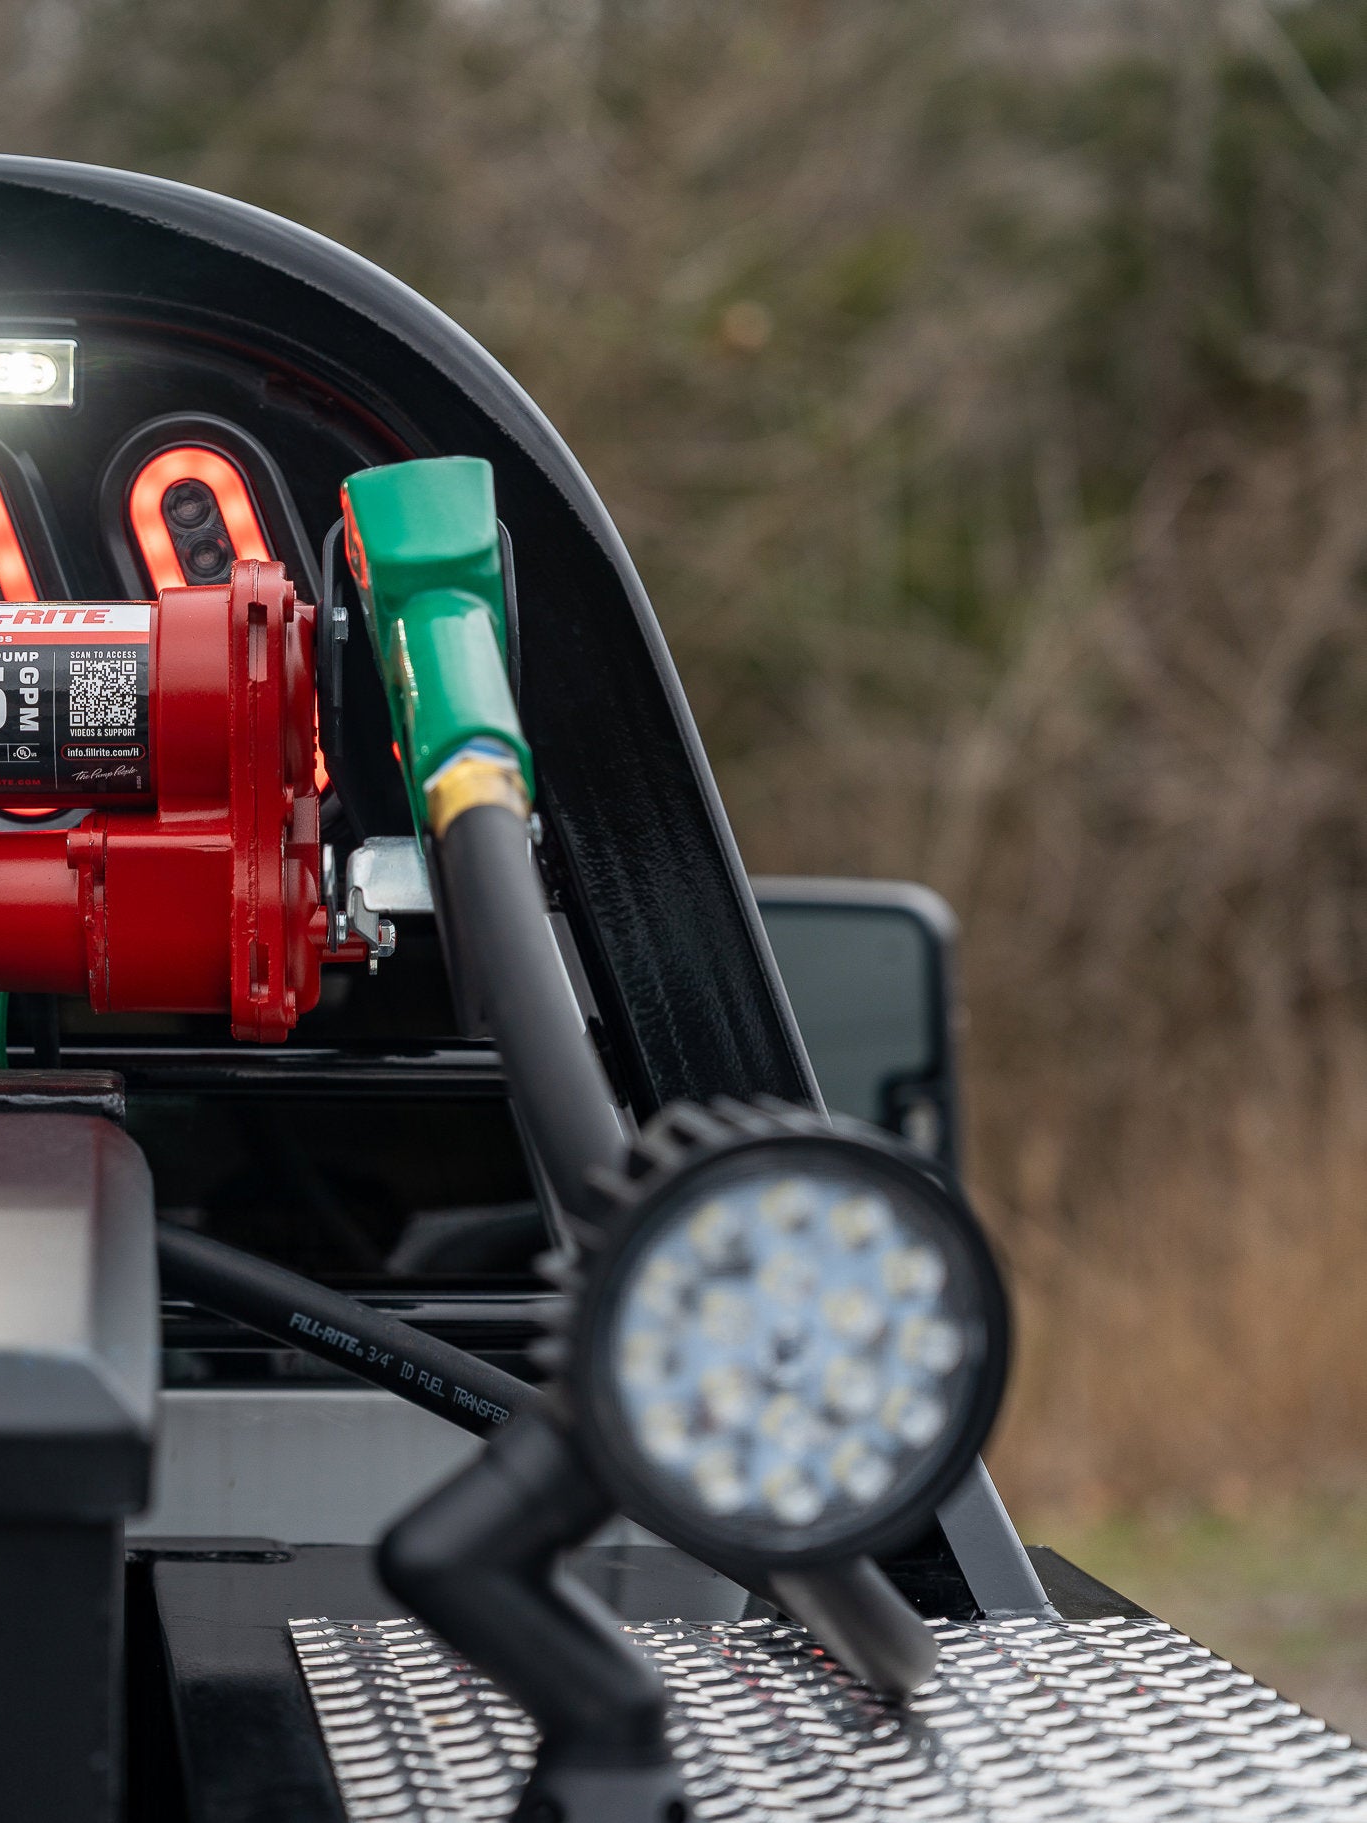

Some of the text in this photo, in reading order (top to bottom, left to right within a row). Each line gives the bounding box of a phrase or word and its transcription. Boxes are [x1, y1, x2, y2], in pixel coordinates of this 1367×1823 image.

[70, 650, 137, 659] SCAN TO ACCESS
[19, 666, 40, 731] GPM
[70, 728, 136, 737] VIDEOS & SUPPORT
[67, 747, 139, 757] info.fillrite.com/H
[289, 1311, 360, 1354] FILL-RITE
[399, 1361, 415, 1380] ID
[417, 1370, 446, 1398] FUEL
[453, 1385, 510, 1427] TRANSFER
